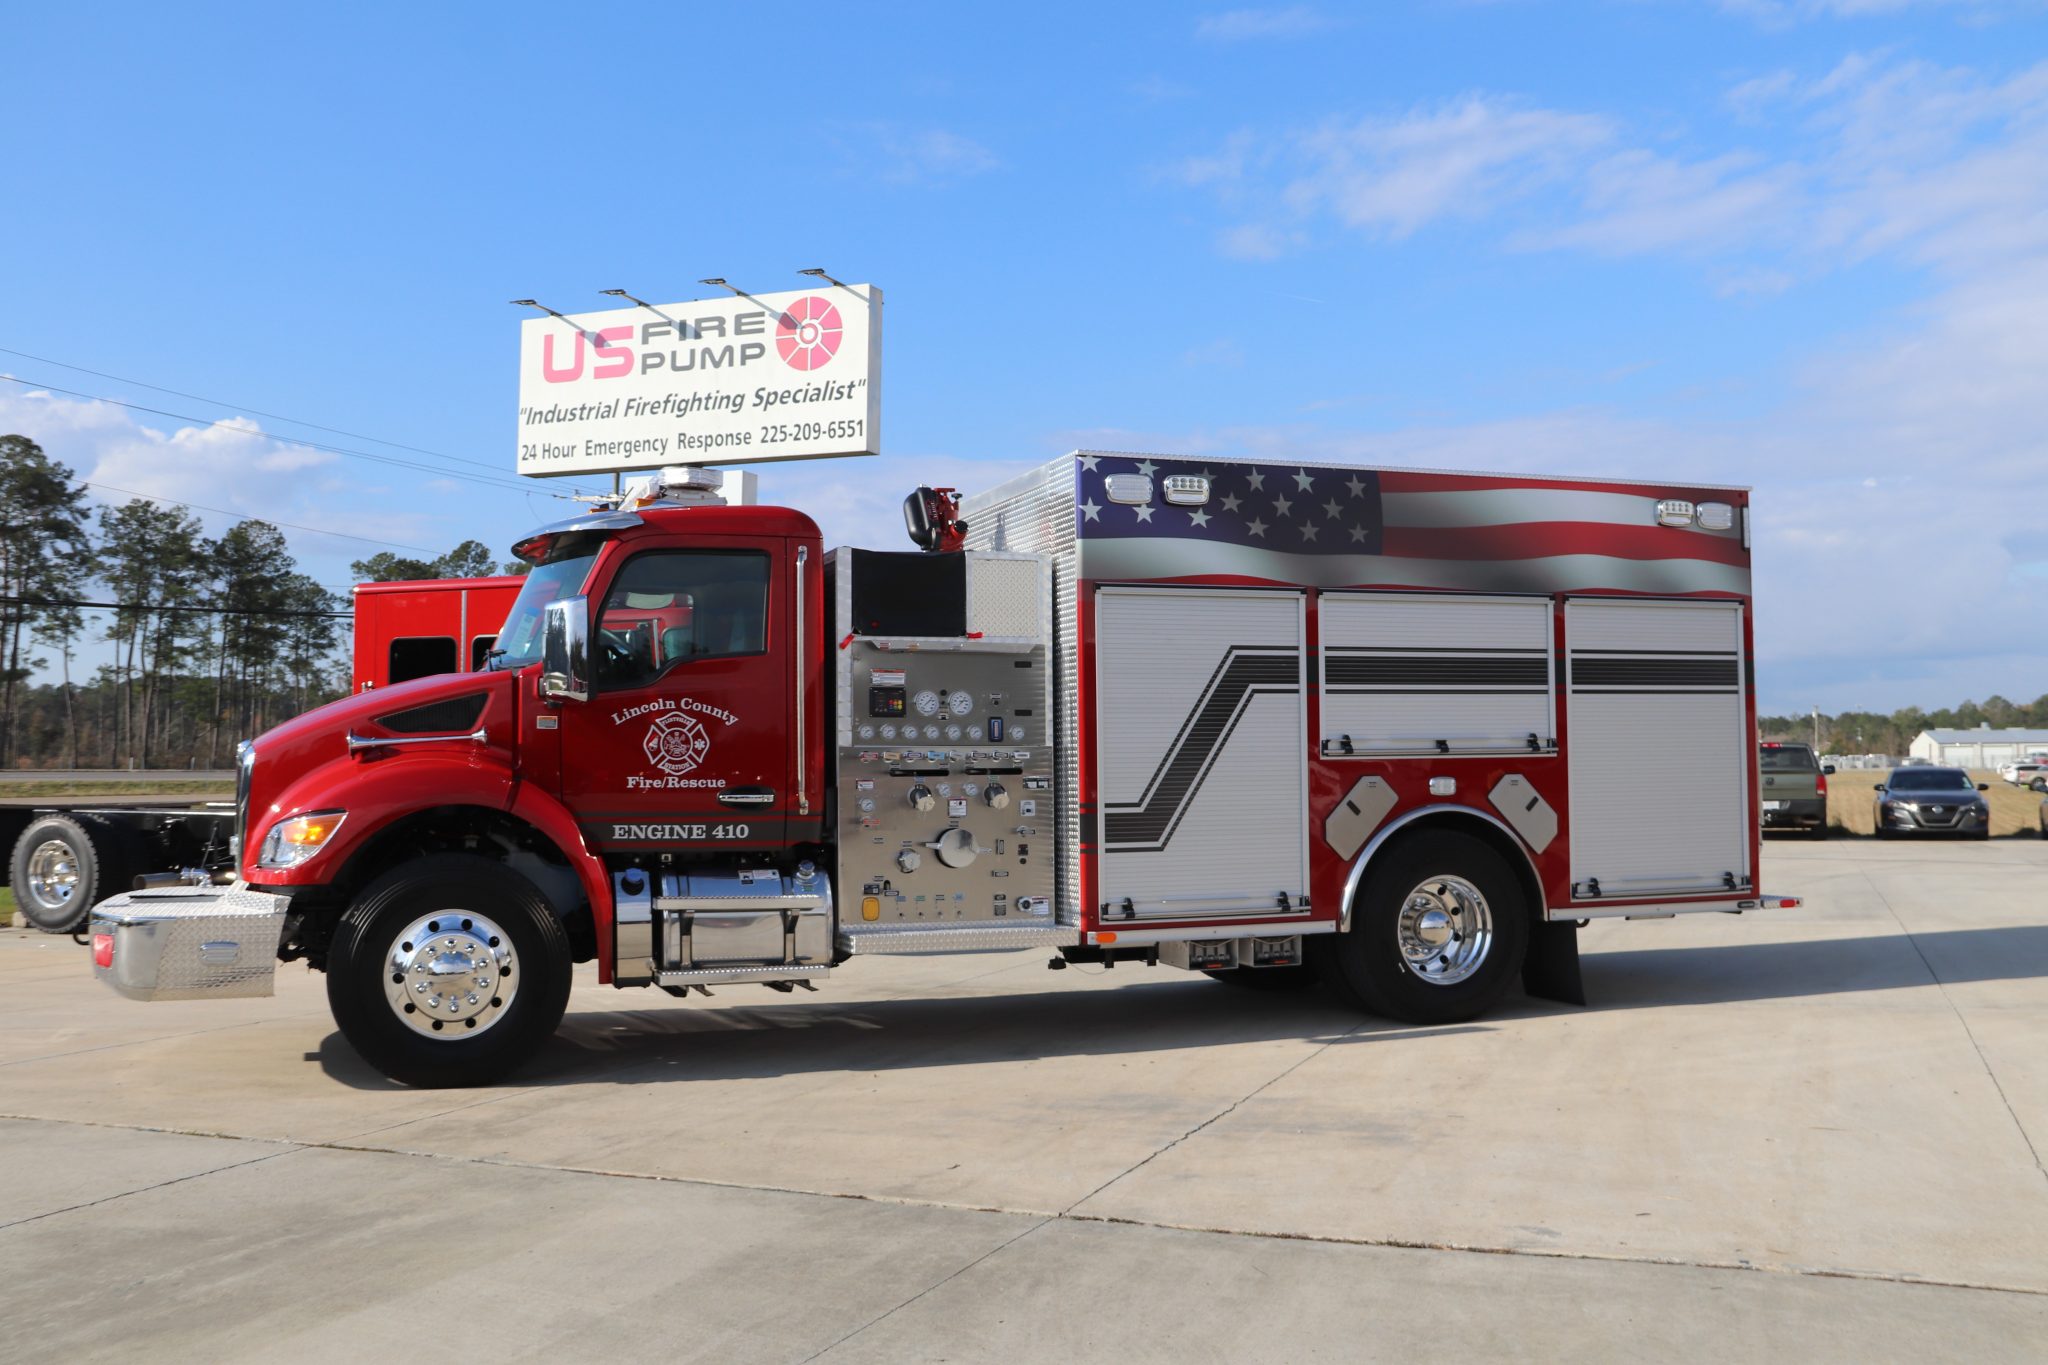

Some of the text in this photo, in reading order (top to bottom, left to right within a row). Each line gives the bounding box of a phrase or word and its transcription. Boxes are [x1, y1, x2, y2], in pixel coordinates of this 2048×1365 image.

[641, 311, 766, 345] FIRE
[543, 325, 635, 384] US
[641, 342, 766, 376] PUMP
[623, 389, 746, 419] Firefighting
[752, 378, 867, 408] Specialist"
[521, 419, 865, 461] 24 Hour Emergency Response 225-209-6551
[611, 697, 740, 727] Lincoln County
[626, 776, 727, 789] Fire/Rescue
[612, 824, 750, 840] ENGINE 410
